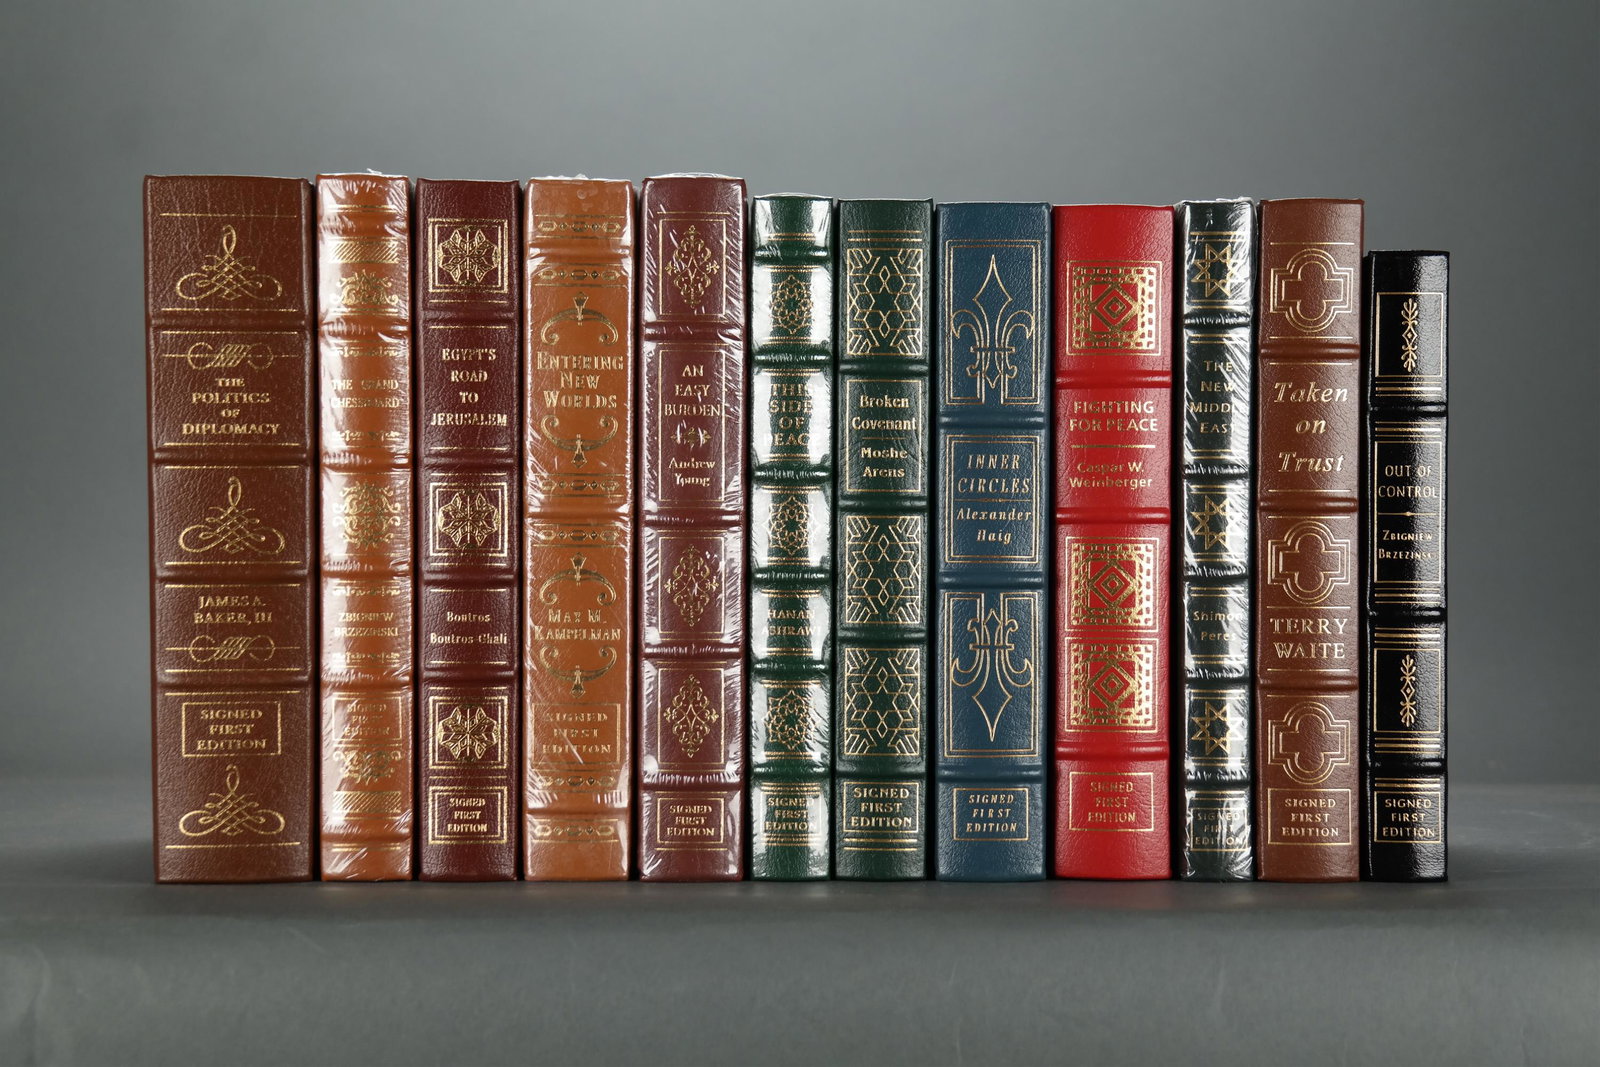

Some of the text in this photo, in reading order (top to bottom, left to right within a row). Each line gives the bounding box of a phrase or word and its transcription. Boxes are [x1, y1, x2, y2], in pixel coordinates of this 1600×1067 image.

[442, 348, 496, 361] EGYPT'S
[682, 365, 704, 377] AN
[1203, 360, 1233, 372] THE
[451, 370, 488, 382] ROAD
[216, 378, 245, 387] THE
[1200, 381, 1236, 392] NEW
[675, 384, 710, 397] EASY
[1273, 381, 1348, 403] Taken
[192, 392, 270, 403] POLITICS
[459, 391, 479, 403] TO
[860, 394, 909, 408] Broken
[664, 404, 721, 416] BURDEN
[1073, 400, 1154, 414] FIGHTING
[221, 409, 240, 418] OF
[430, 412, 508, 426] JERUSALEM
[779, 416, 805, 429] OF
[851, 416, 917, 431] Covenant
[1069, 418, 1159, 432] FOR PEACE
[1295, 419, 1327, 434] on
[182, 423, 280, 435] DIPLOMACY
[861, 447, 908, 459] Moshe
[668, 457, 716, 469] Andrew
[967, 454, 1020, 470] INNER
[1076, 461, 1144, 475] Caspar W.
[1278, 451, 1345, 473] Trust
[862, 466, 905, 478] Arens
[1384, 464, 1432, 477] OUT OF
[675, 473, 710, 487] Young
[957, 477, 1030, 494] CIRCLES
[1068, 476, 1152, 490] Weinberger
[1378, 485, 1438, 498] CONTROL
[956, 507, 1032, 521] Alexander
[976, 529, 1012, 545] Haig
[199, 596, 266, 609] JAMES A.
[194, 612, 273, 625] BAKER, III
[447, 611, 491, 622] Boutros
[588, 609, 607, 624] M.
[767, 609, 815, 619] HANAN
[1269, 618, 1348, 635] TERRY
[1200, 631, 1237, 641] Peres
[1272, 642, 1346, 659] WAITE
[200, 709, 263, 720] SIGNED
[543, 712, 608, 722] SIGNED
[209, 724, 254, 735] FIRST
[197, 738, 267, 751] EDITION
[853, 787, 910, 799] SIGNED
[1090, 781, 1134, 793] SIGNED
[449, 798, 486, 807] SIGNED
[768, 797, 815, 807] SIGNED
[968, 794, 1014, 804] SIGNED
[1095, 796, 1129, 808] FIRST
[1284, 798, 1337, 808] SIGNED
[1384, 798, 1432, 809] SIGNED
[669, 805, 713, 814] SIGNED
[860, 802, 903, 813] FIRST
[972, 808, 1011, 818] FIRST
[454, 811, 481, 820] FIRST
[774, 809, 809, 819] FIRST
[1088, 811, 1136, 823] EDITION
[1291, 812, 1331, 823] FIRST
[1391, 812, 1426, 822] FIRST
[675, 816, 707, 825] FIRST
[764, 821, 817, 831] EDITION
[851, 816, 912, 828] EDITION
[447, 823, 488, 833] EDITION
[666, 827, 715, 836] EDITION
[966, 822, 1017, 833] EDITION
[1204, 824, 1234, 833] FIRT
[1281, 826, 1339, 837] EDITION
[1382, 826, 1435, 837] EDITION
